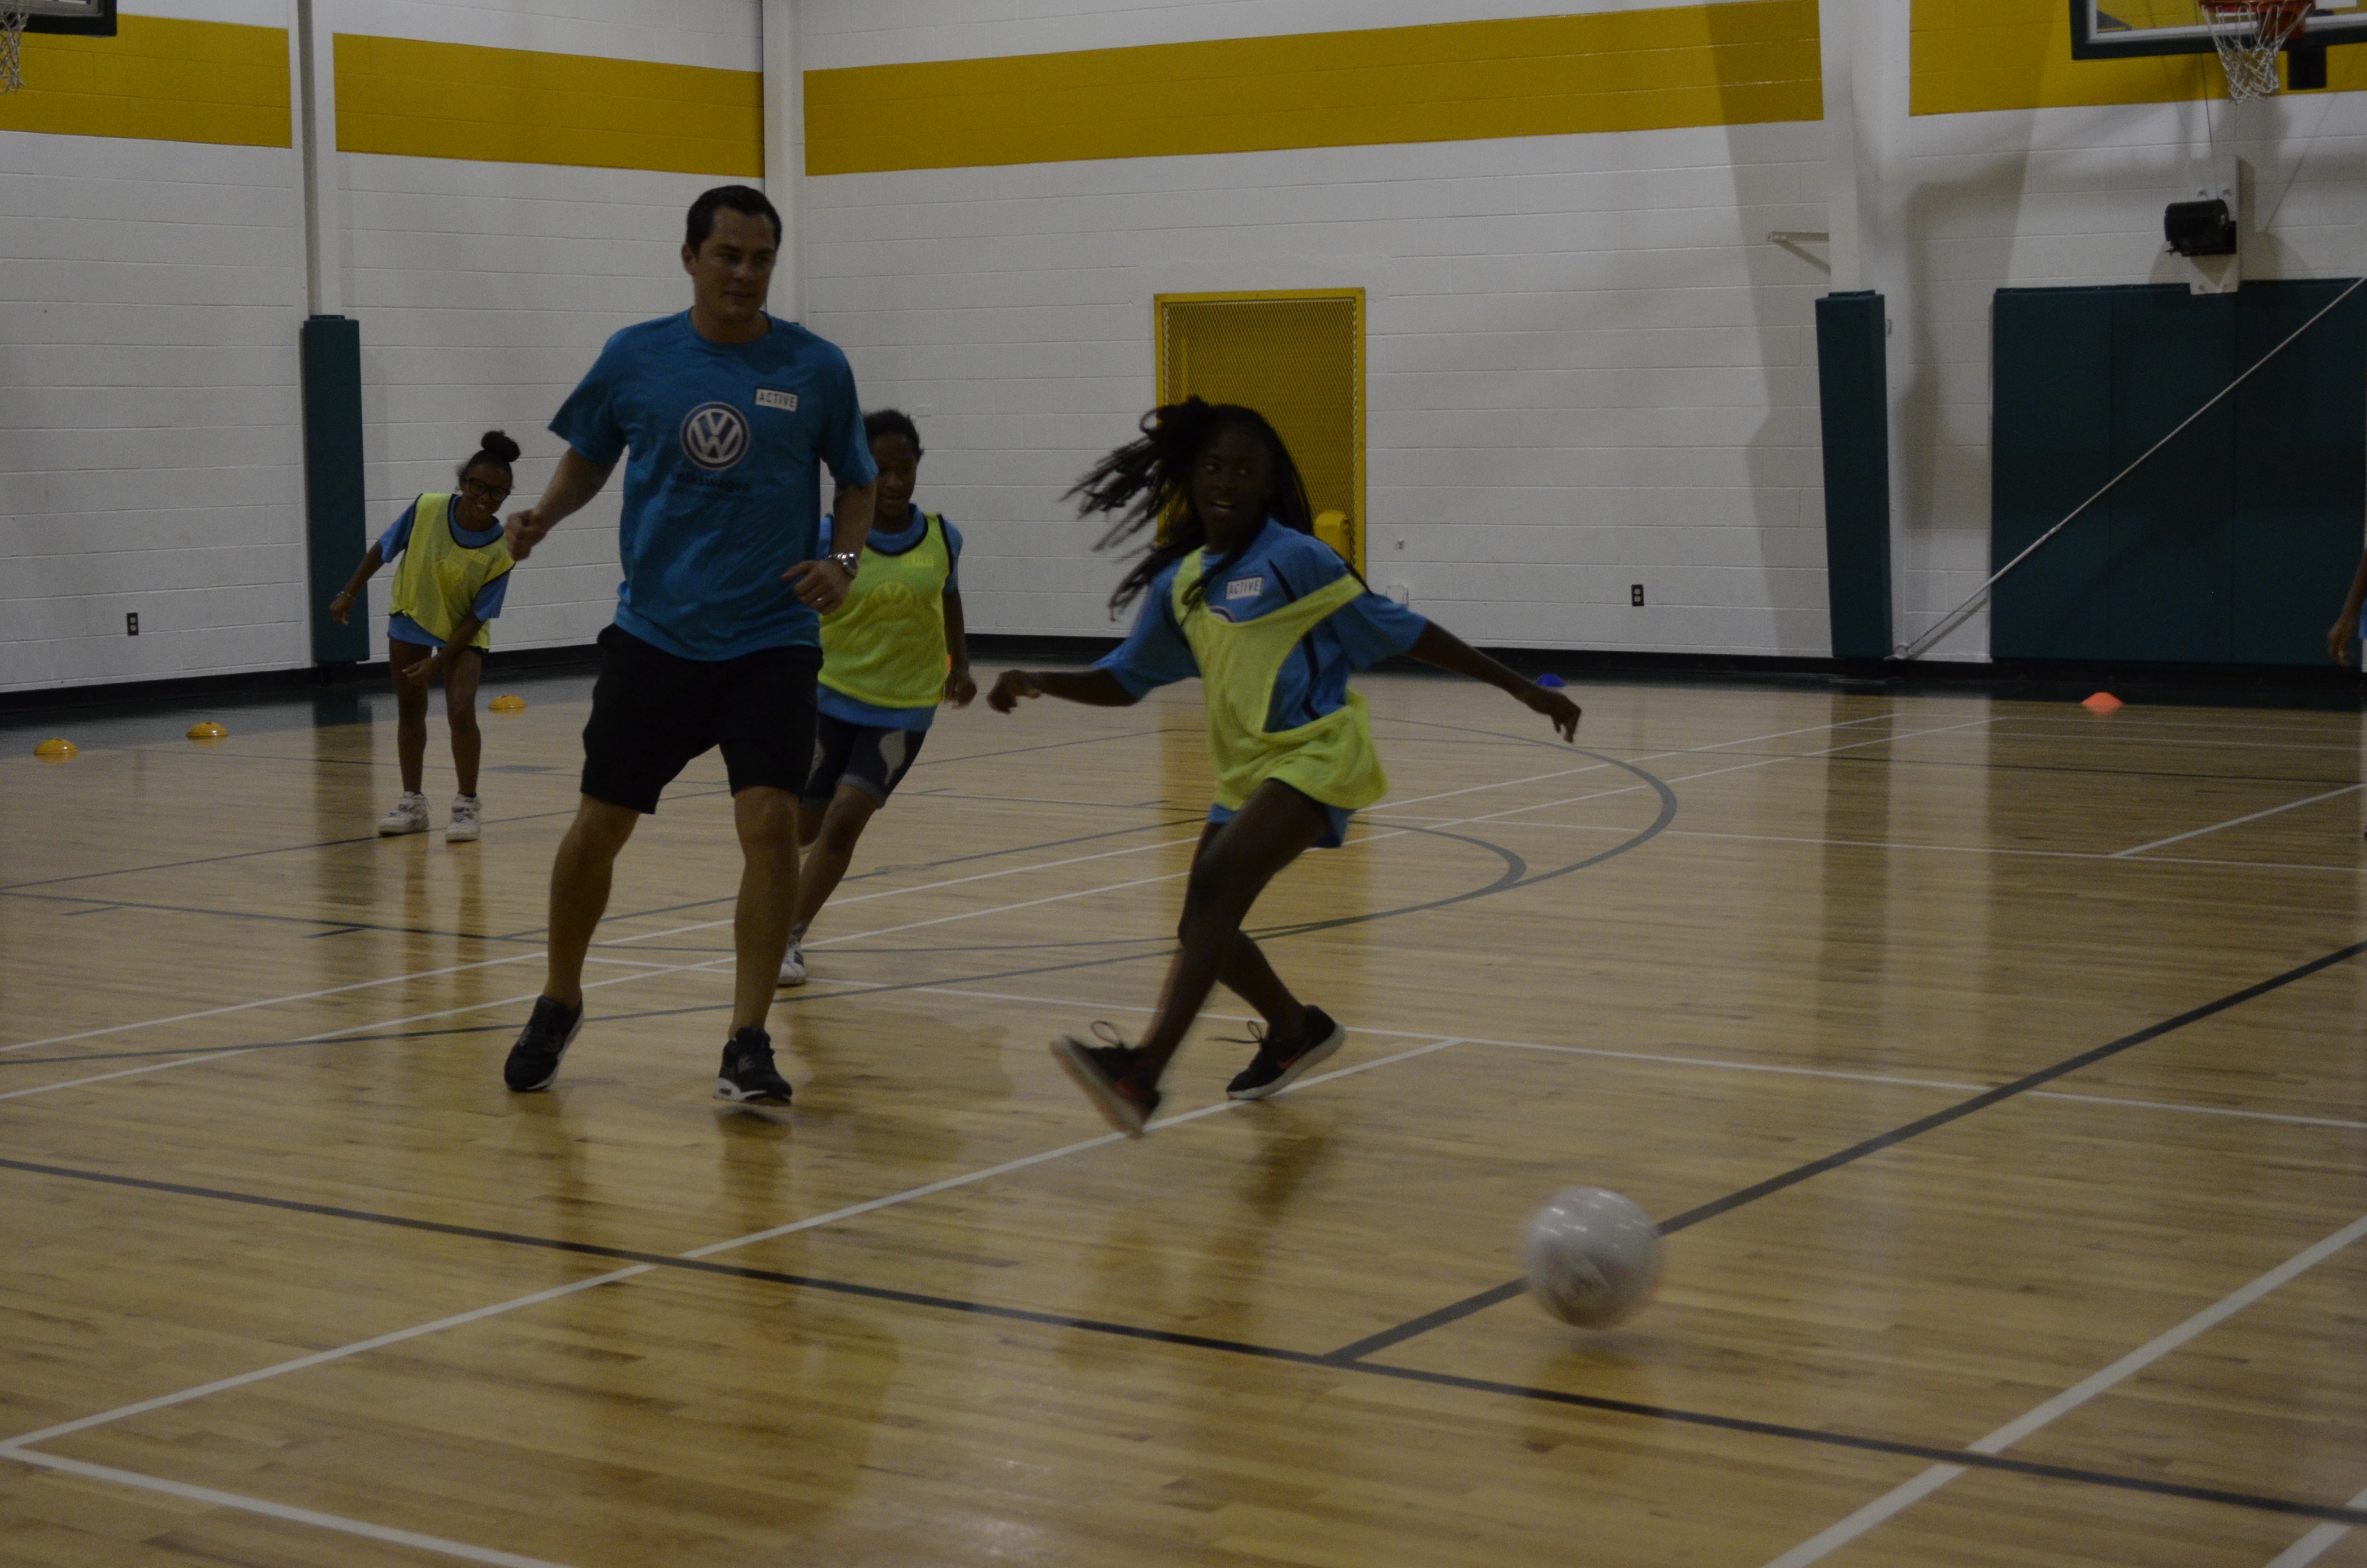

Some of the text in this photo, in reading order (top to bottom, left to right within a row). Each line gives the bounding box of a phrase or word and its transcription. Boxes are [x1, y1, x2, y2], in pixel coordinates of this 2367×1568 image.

[758, 392, 795, 408] ACTIVE
[687, 408, 744, 463] VW
[1229, 581, 1259, 594] ACTIVE
